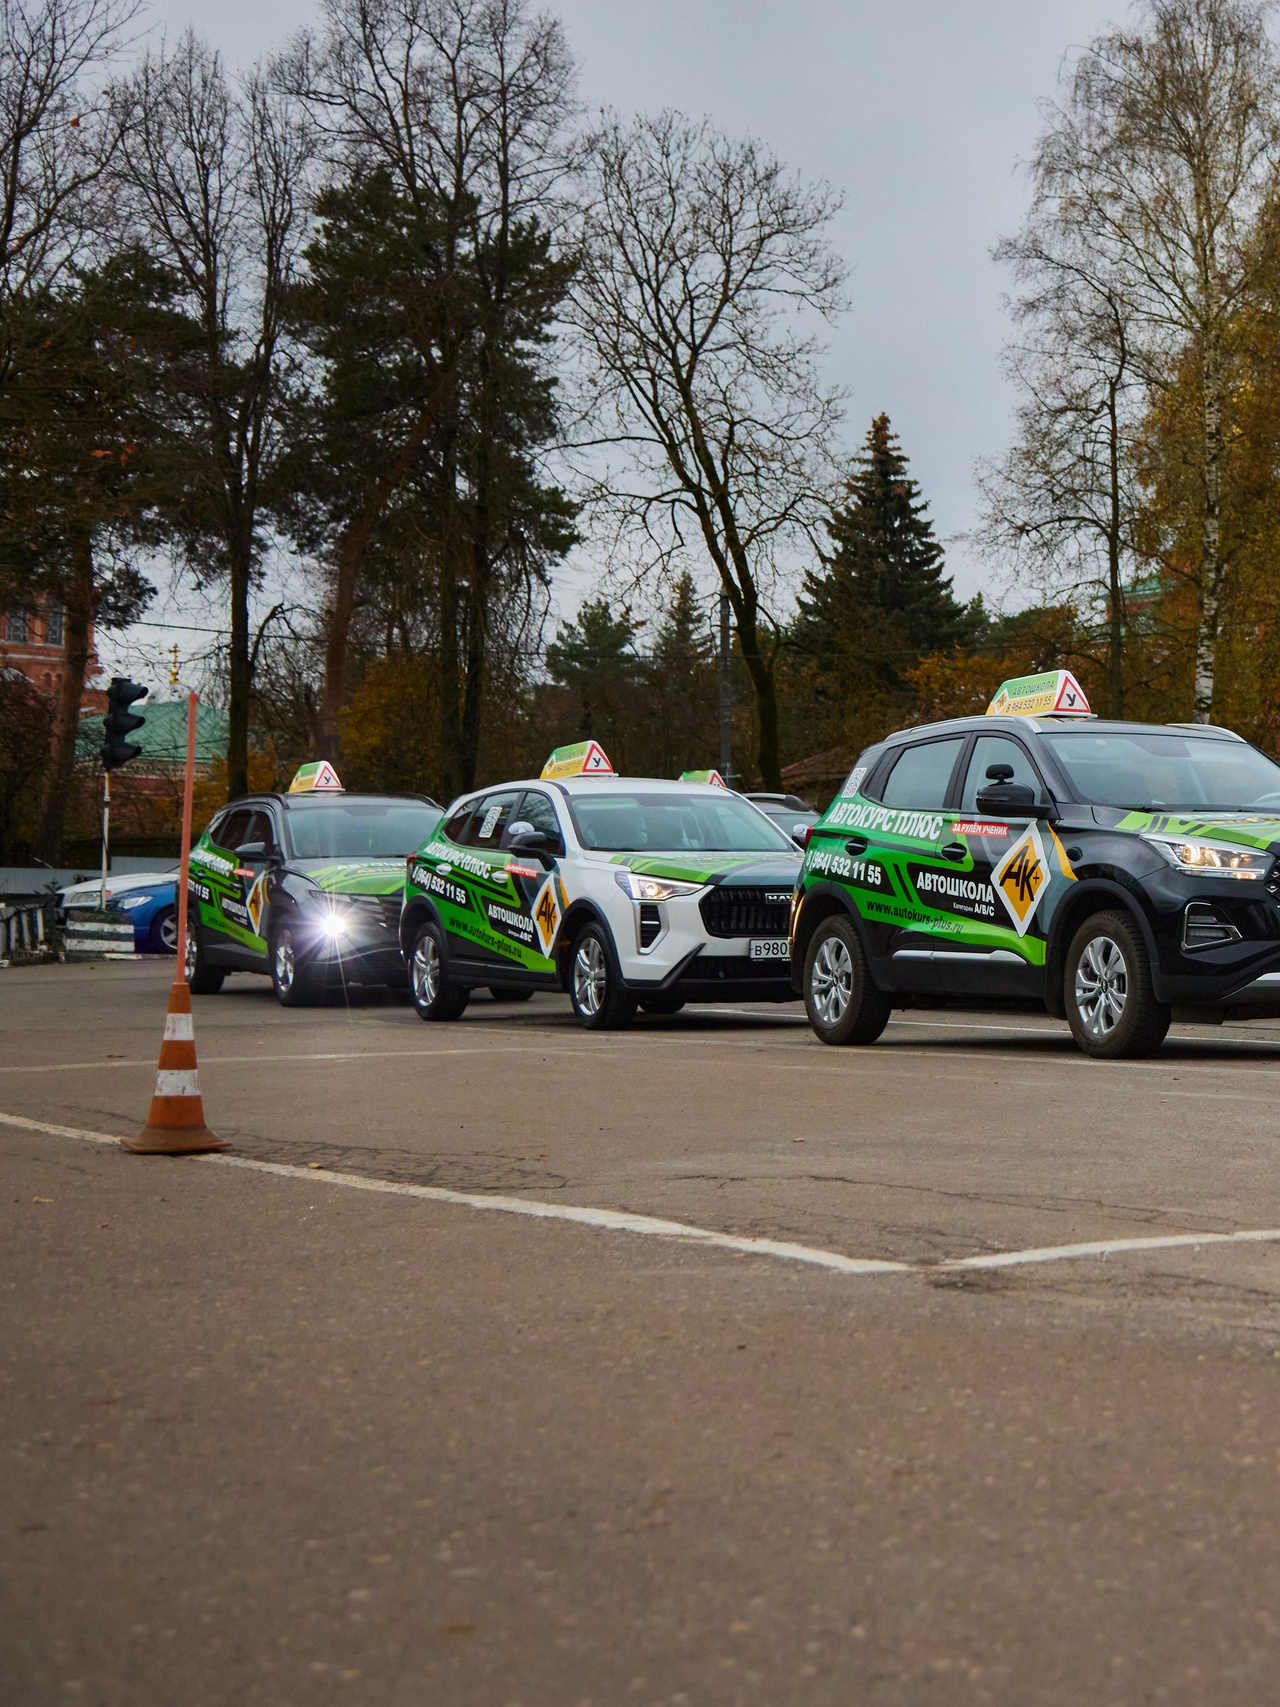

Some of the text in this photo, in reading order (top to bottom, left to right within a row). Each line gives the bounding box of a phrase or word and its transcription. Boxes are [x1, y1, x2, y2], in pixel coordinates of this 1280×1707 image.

[1012, 681, 1055, 696] АВТОШКОЛА
[1011, 701, 1022, 712] 964
[1023, 698, 1035, 710] 532
[1036, 697, 1042, 708] 11
[1043, 695, 1052, 706] 55
[1066, 693, 1076, 707] У
[592, 757, 601, 768] У
[324, 776, 331, 784] У
[825, 802, 943, 840] АВТОКУРС ПЛЮС
[952, 823, 1008, 836] ЗА РУЛЁМ УЧЕНИК
[423, 841, 465, 866] АВТОКУРС
[462, 855, 491, 880] ПЛЮС
[806, 850, 813, 867] 8
[831, 856, 851, 876] 532
[852, 861, 866, 881] 11
[867, 865, 882, 885] 55
[201, 886, 210, 900] 55
[430, 875, 445, 895] 532
[446, 882, 455, 899] 11
[456, 887, 466, 904] 55
[916, 872, 995, 904] АВТОШКОЛА
[488, 903, 534, 933] АВТОШКОЛА
[867, 901, 964, 934] www.autokurs-plus.ru
[755, 942, 788, 956] В980
